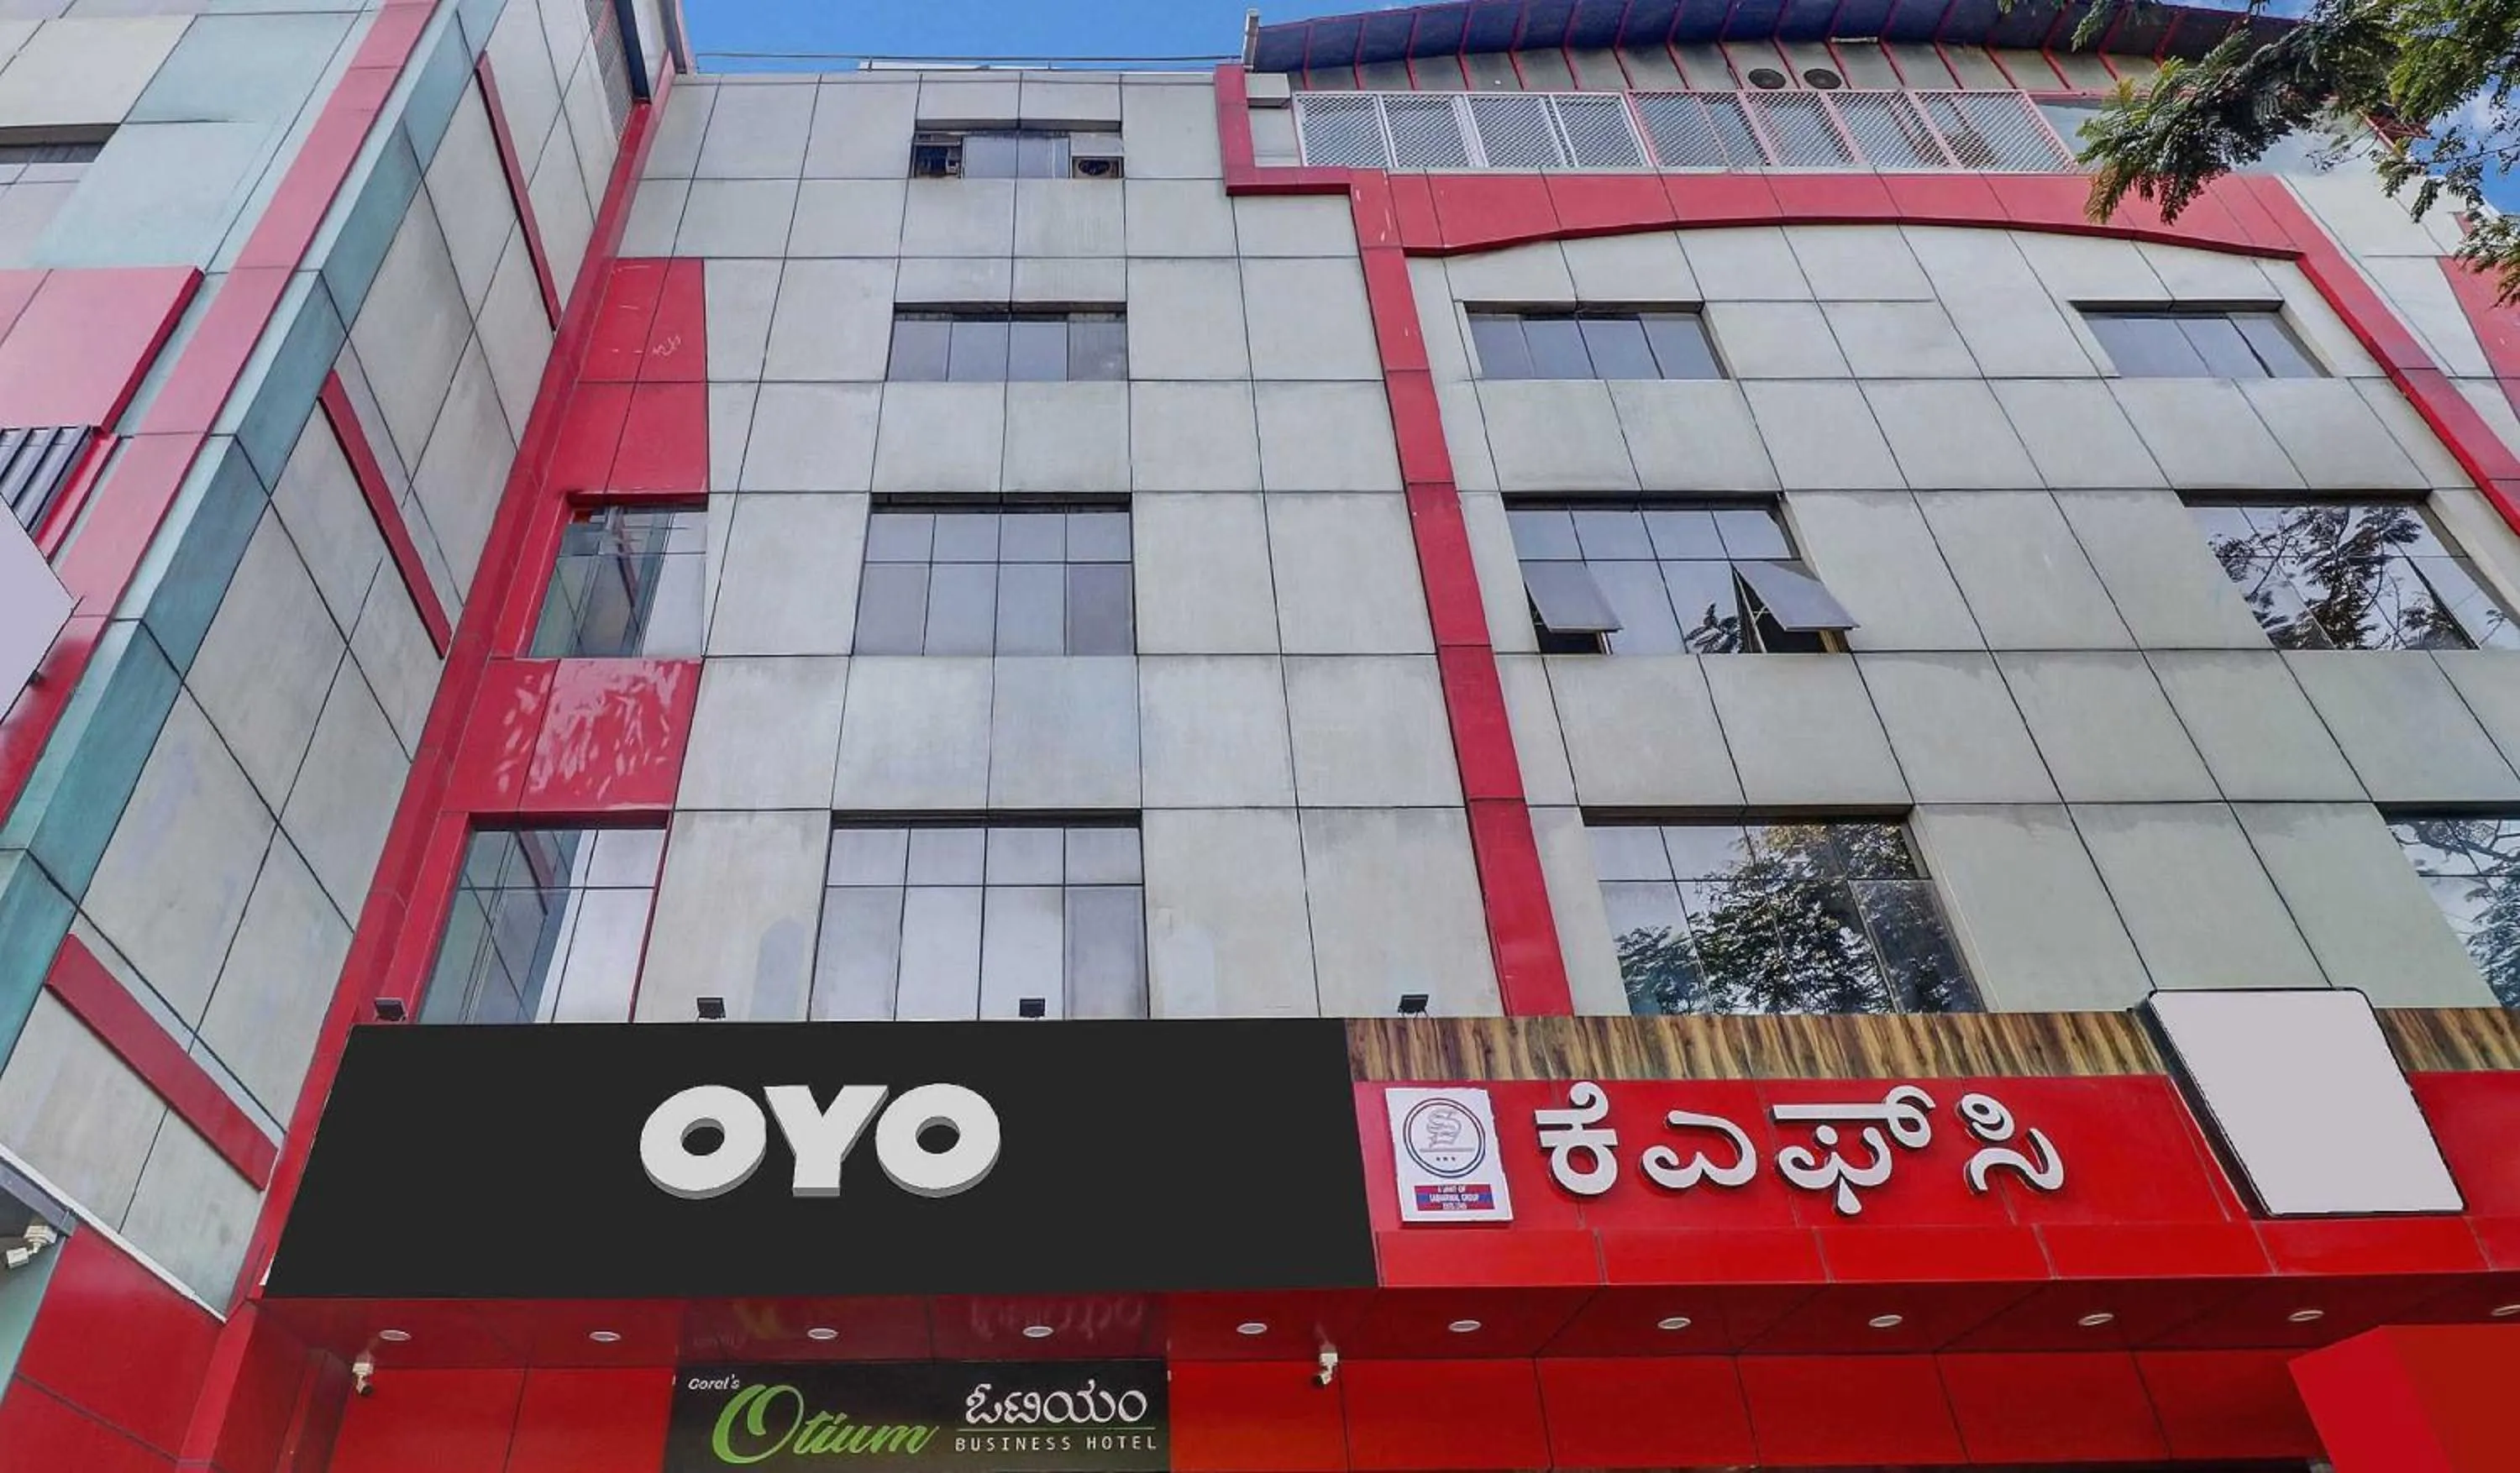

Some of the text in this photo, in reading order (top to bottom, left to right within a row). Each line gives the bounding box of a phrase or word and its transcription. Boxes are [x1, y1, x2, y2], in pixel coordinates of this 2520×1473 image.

[640, 1083, 1000, 1199] OYO
[712, 1384, 940, 1464] Otium
[966, 1379, 1147, 1424] ಓಟಿಯಂ
[955, 1435, 1157, 1452] BUSINESS HOTEL
